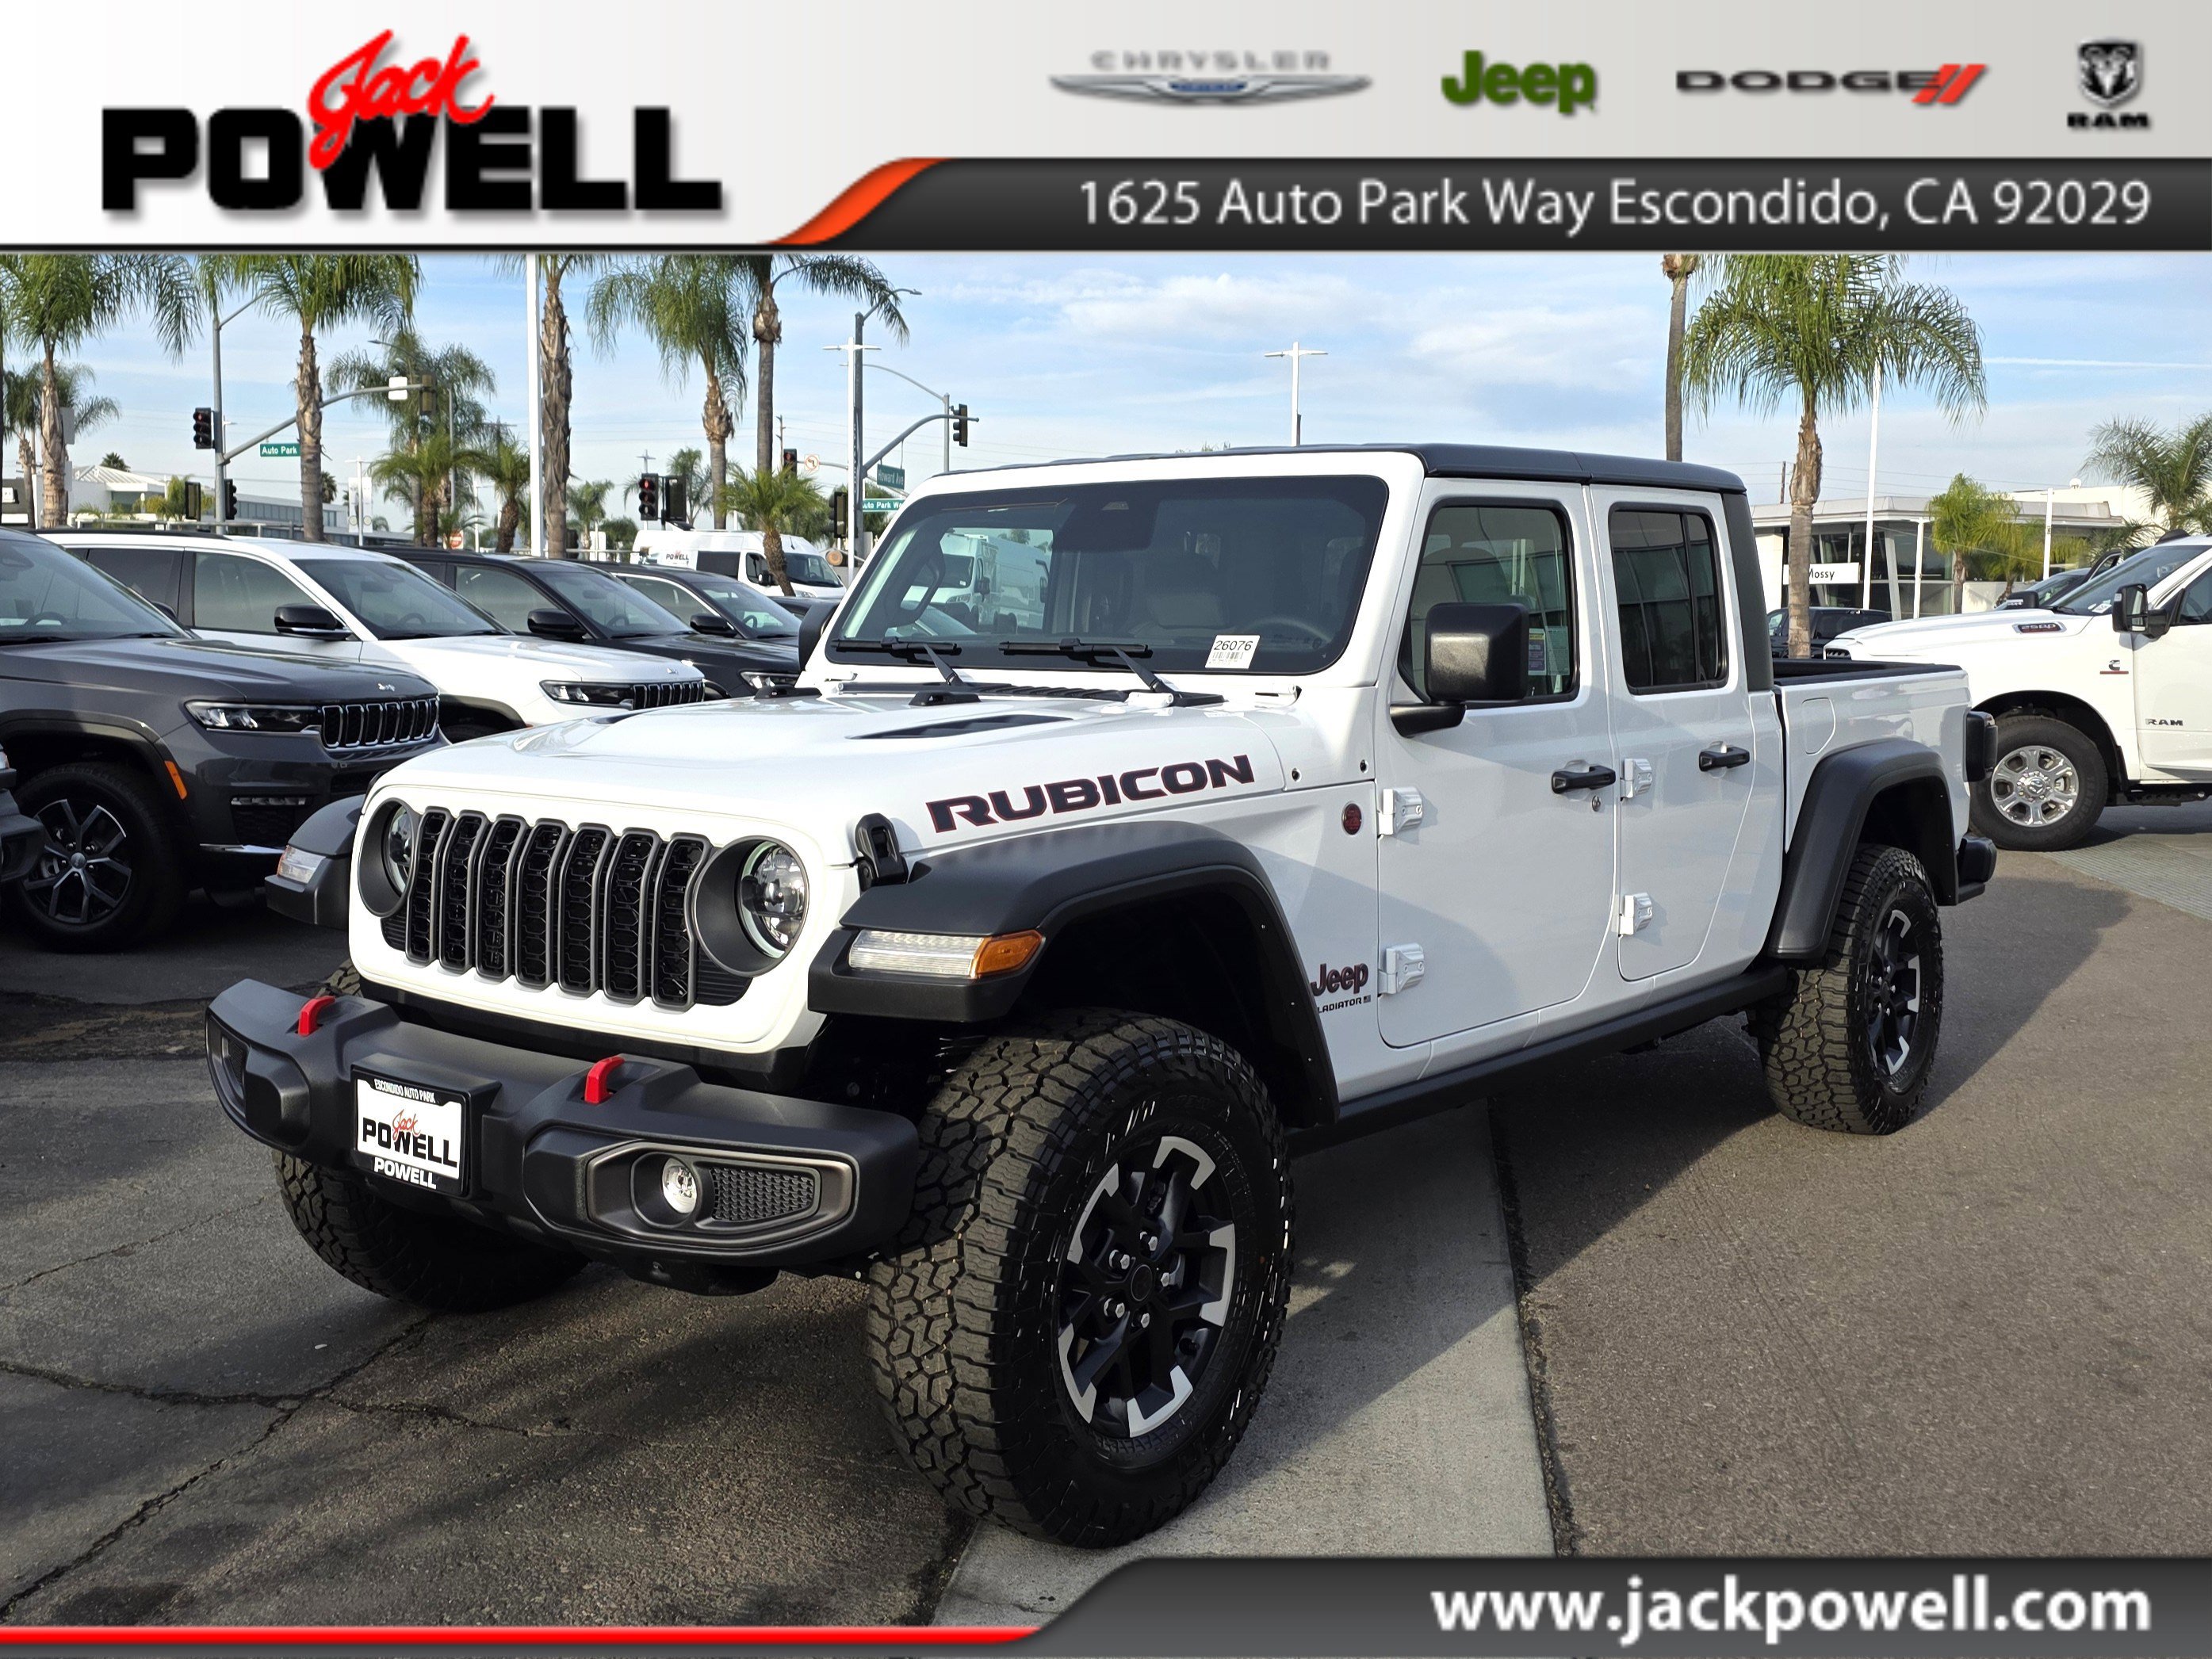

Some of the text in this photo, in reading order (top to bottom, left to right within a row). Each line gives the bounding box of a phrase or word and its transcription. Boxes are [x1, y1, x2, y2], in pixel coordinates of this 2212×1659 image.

[281, 445, 297, 454] Park
[1214, 640, 1253, 651] 26076
[925, 755, 1255, 833] RUBICON
[1311, 963, 1368, 996] Jeep
[1317, 997, 1362, 1013] LADIATOR
[374, 1079, 436, 1103] ESCONDIDO AUTO PARK
[392, 1109, 421, 1141] Jack
[363, 1118, 457, 1168] POWELL
[374, 1157, 436, 1189] POWELL
